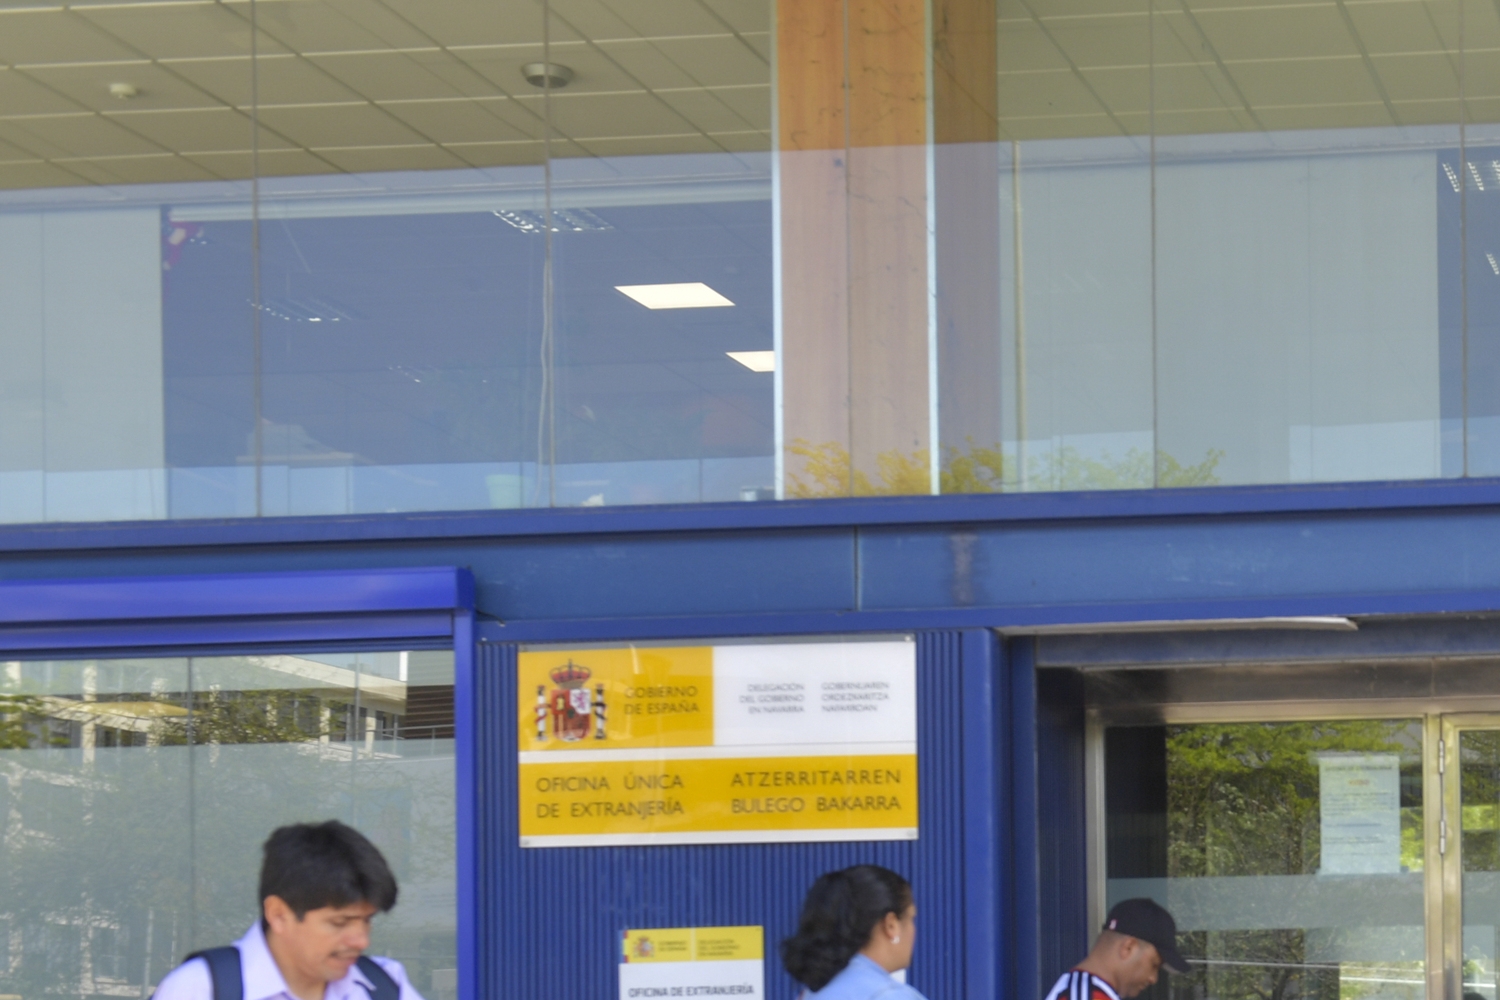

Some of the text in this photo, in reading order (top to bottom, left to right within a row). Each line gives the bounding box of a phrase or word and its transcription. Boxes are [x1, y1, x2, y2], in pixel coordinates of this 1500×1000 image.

[624, 685, 698, 699] GOBIERNO
[624, 699, 699, 715] DE ESPAÑA
[535, 772, 684, 793] OFICINA ÚNICA
[730, 769, 901, 787] ATZERRITARREN
[536, 797, 684, 820] DE EXTRANJERÍA
[731, 795, 901, 814] BULEGO BAKARRA
[628, 982, 754, 998] OFICINA DE EXTRANJERÍA
